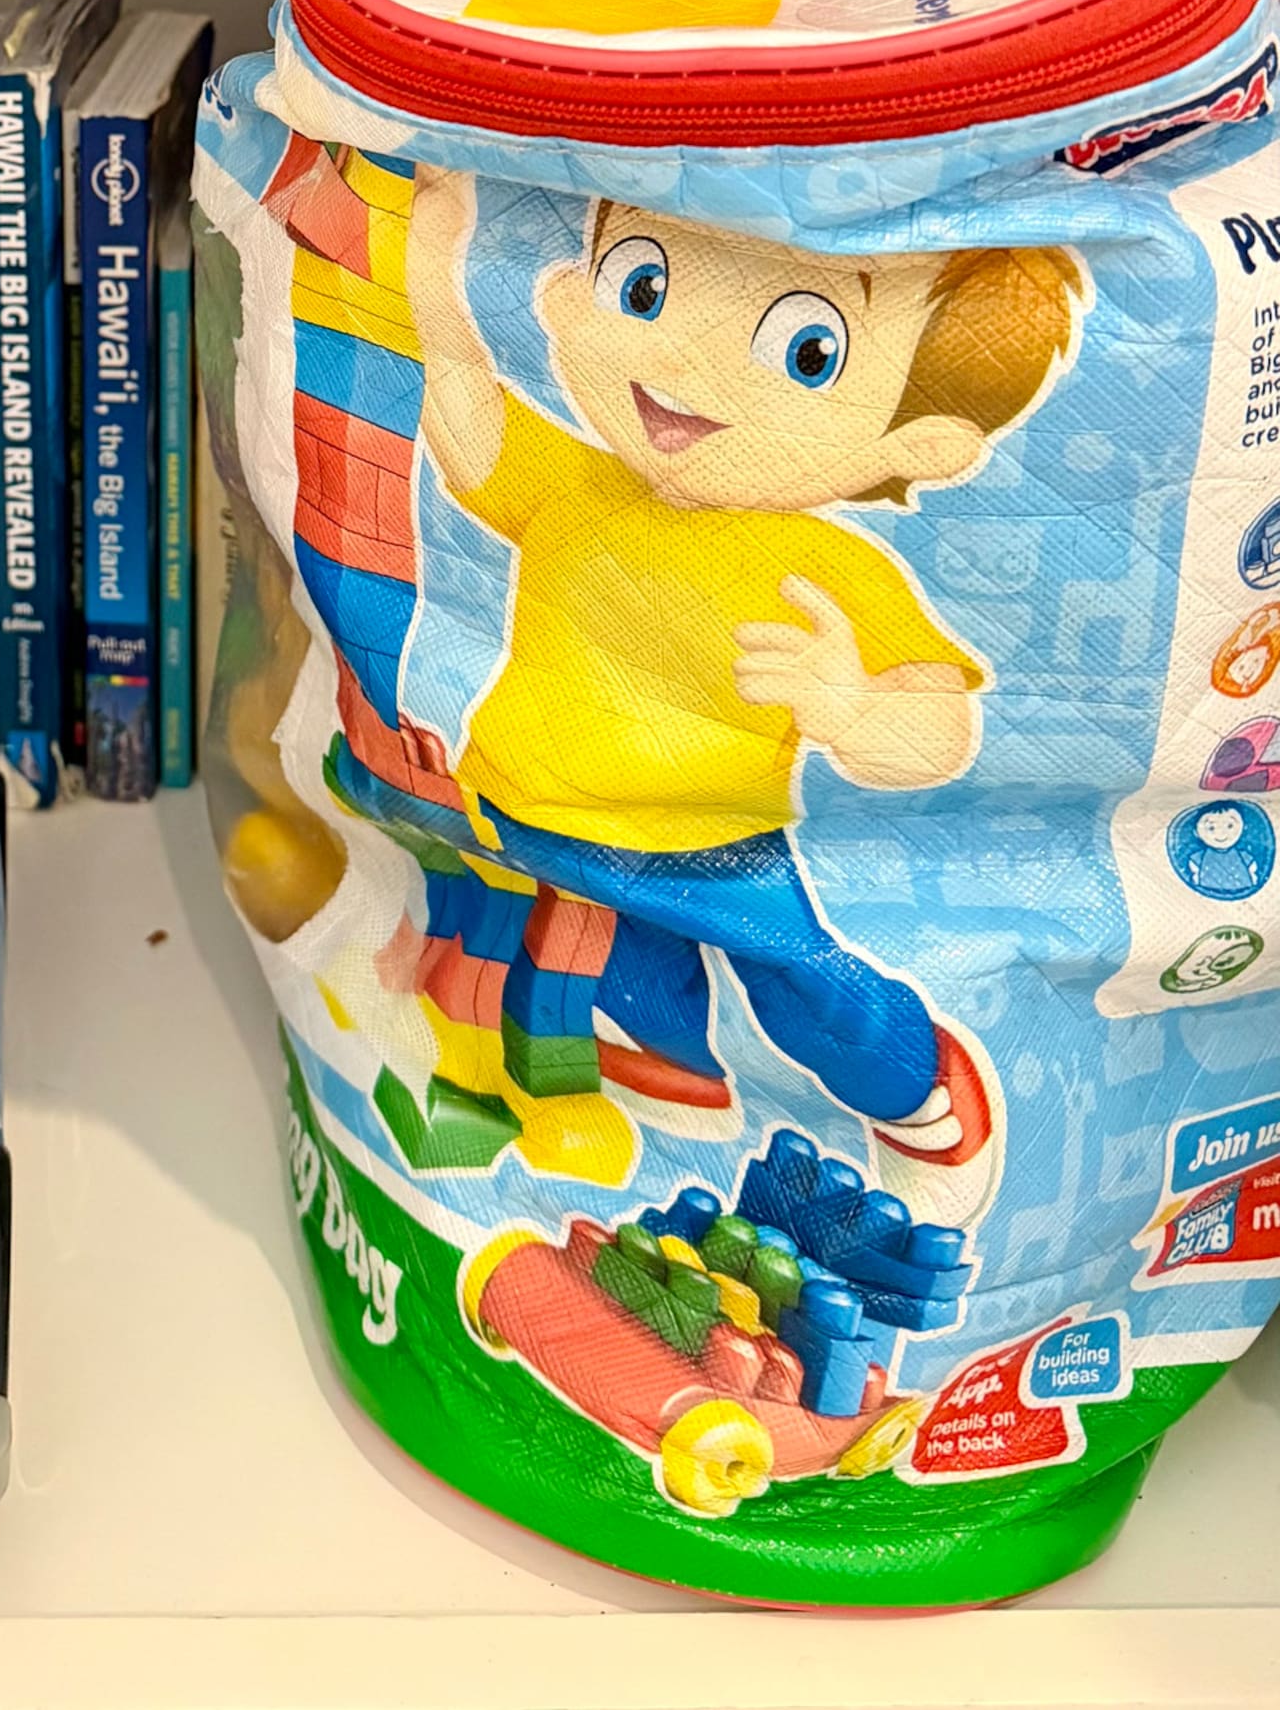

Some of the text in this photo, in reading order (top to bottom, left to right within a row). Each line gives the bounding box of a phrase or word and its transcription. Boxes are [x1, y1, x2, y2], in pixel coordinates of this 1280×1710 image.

[0, 276, 29, 328] BIG
[1252, 329, 1274, 352] of
[0, 335, 32, 441] ISLAND
[98, 424, 124, 469] the
[93, 474, 124, 518] Big
[3, 447, 36, 590] REVEALED
[99, 524, 124, 601] Island
[1189, 1127, 1250, 1172] Join
[1176, 1201, 1234, 1241] Family
[1166, 1223, 1229, 1265] CLUB
[1038, 1346, 1110, 1368] building
[1062, 1332, 1091, 1348] For
[1051, 1369, 1100, 1387] ideas
[958, 1431, 1007, 1452] back
